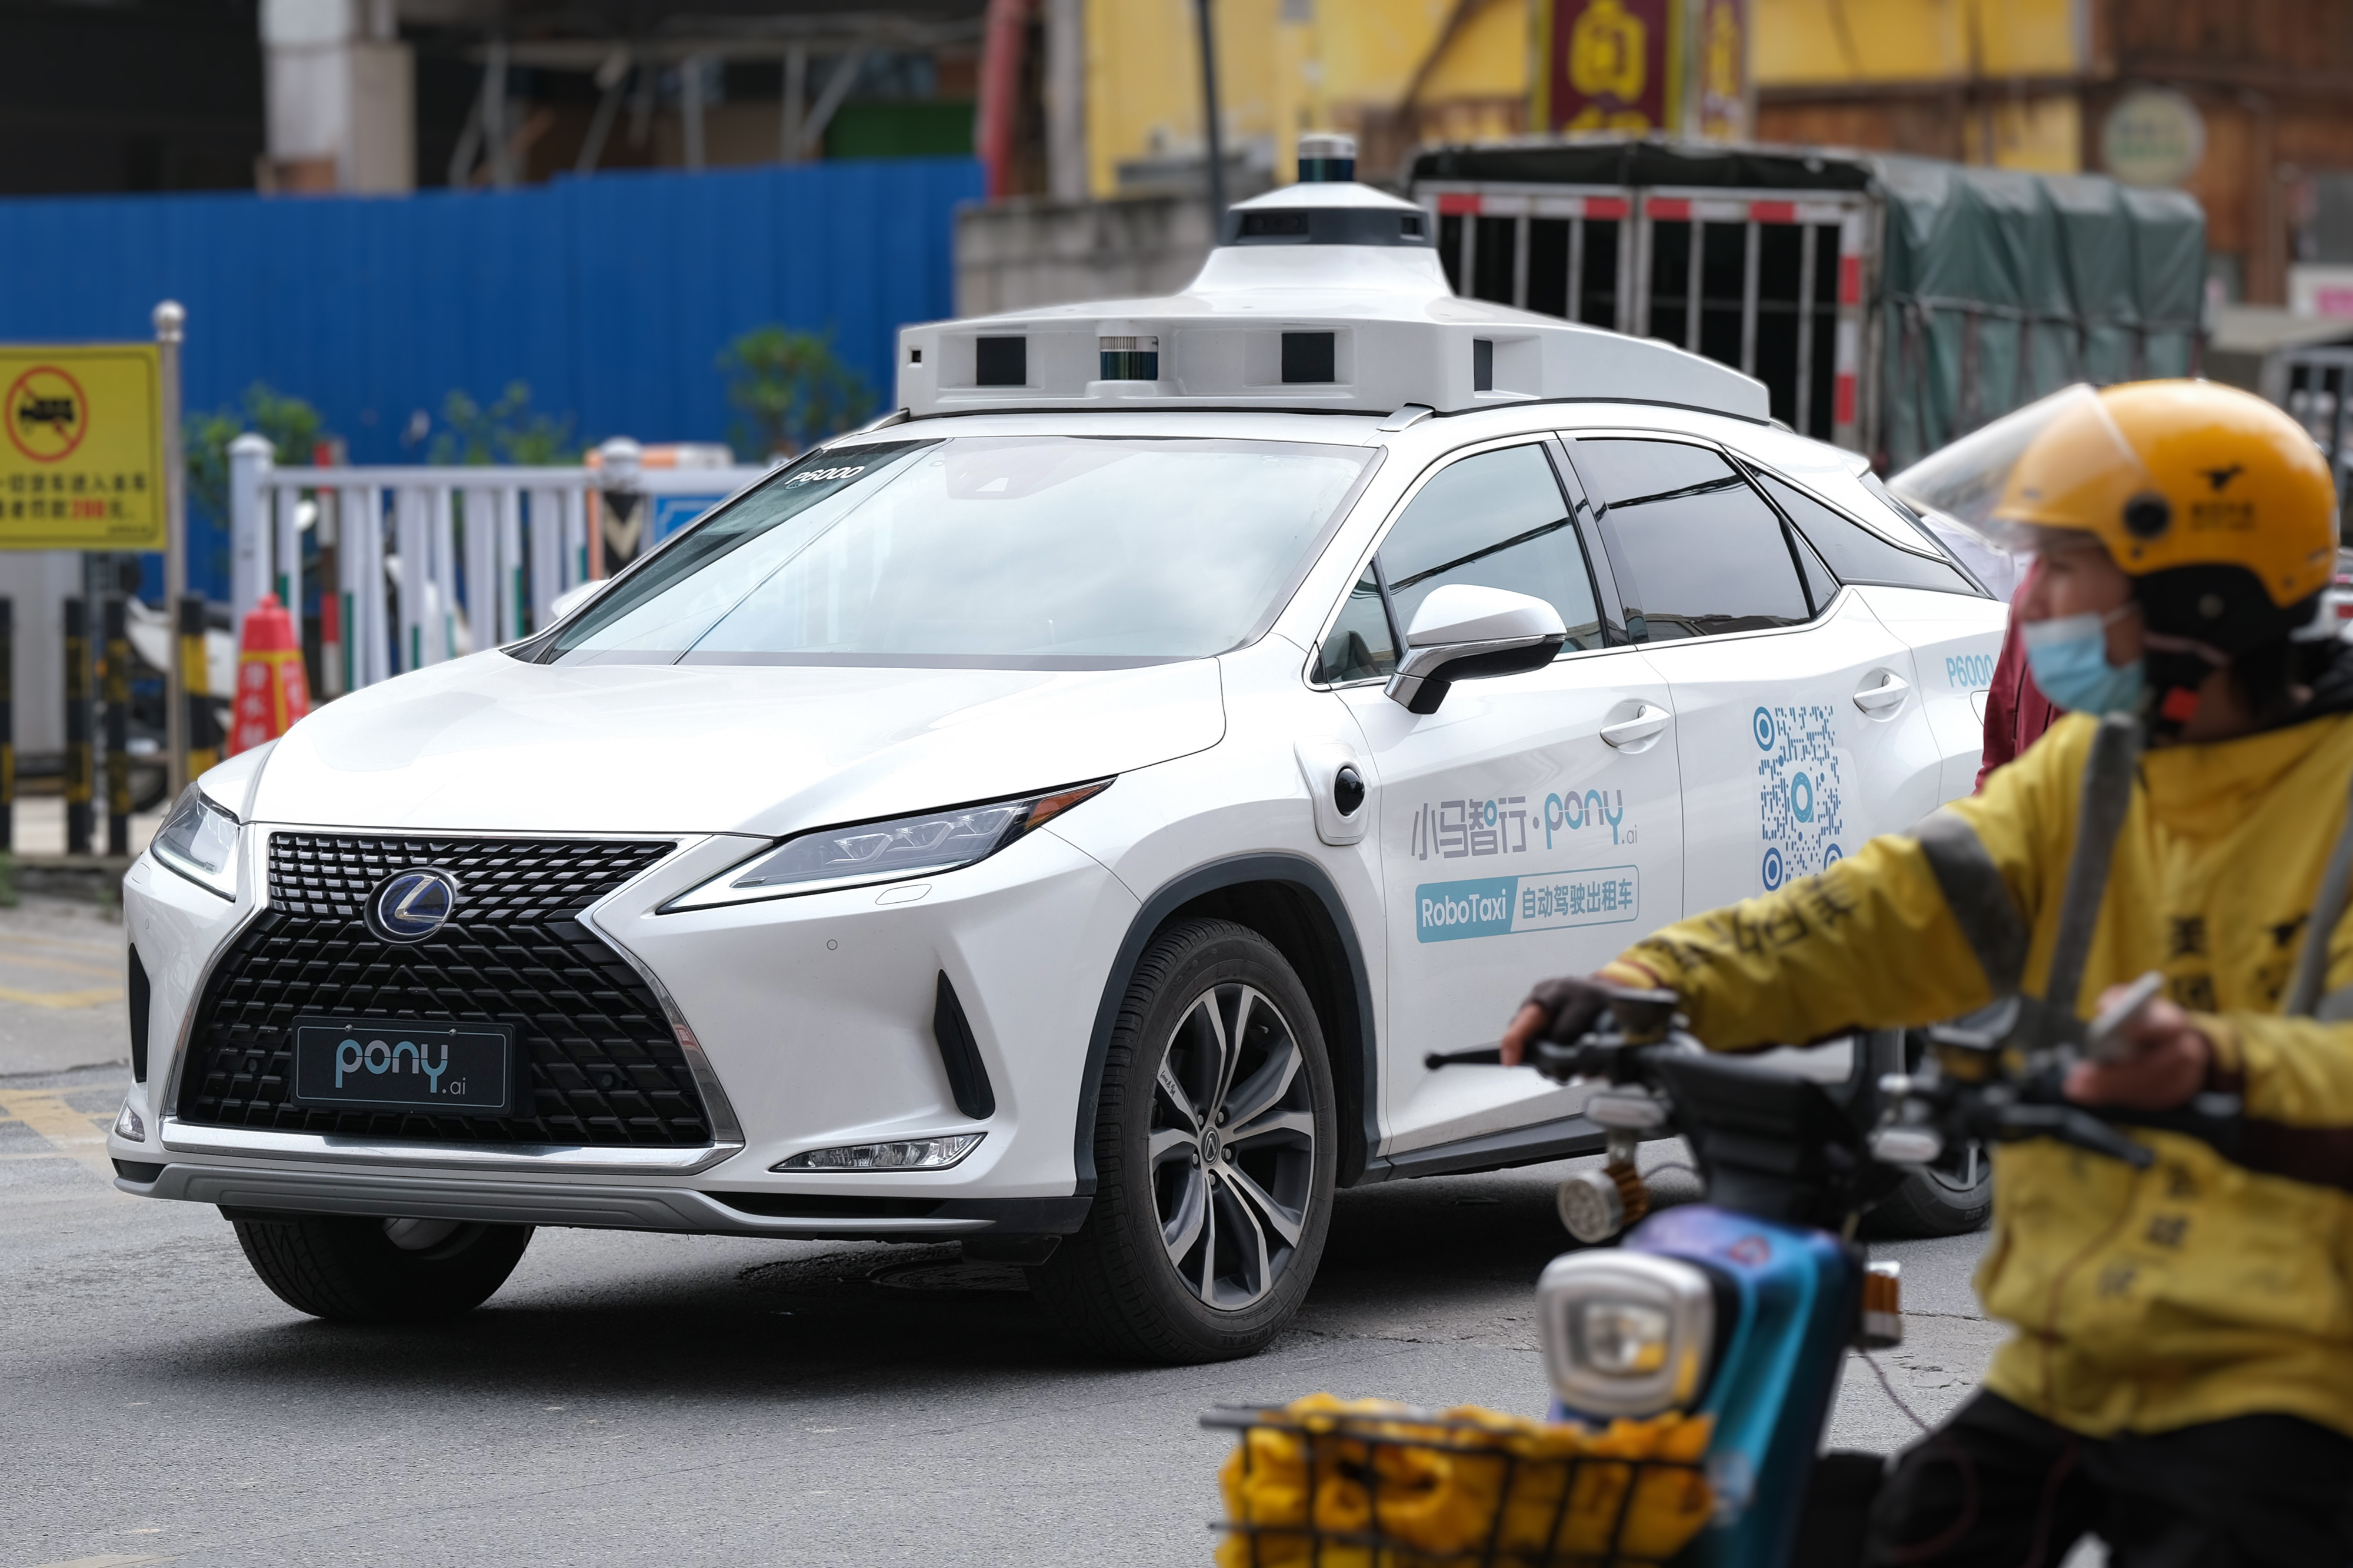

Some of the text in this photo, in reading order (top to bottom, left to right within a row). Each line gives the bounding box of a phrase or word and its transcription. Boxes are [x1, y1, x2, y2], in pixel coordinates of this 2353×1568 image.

[785, 466, 865, 485] P6000
[1945, 654, 1995, 688] P6000
[1411, 796, 1527, 861] 小马智行
[1421, 878, 1634, 928] RoboTaxi 自动驾驶出租车
